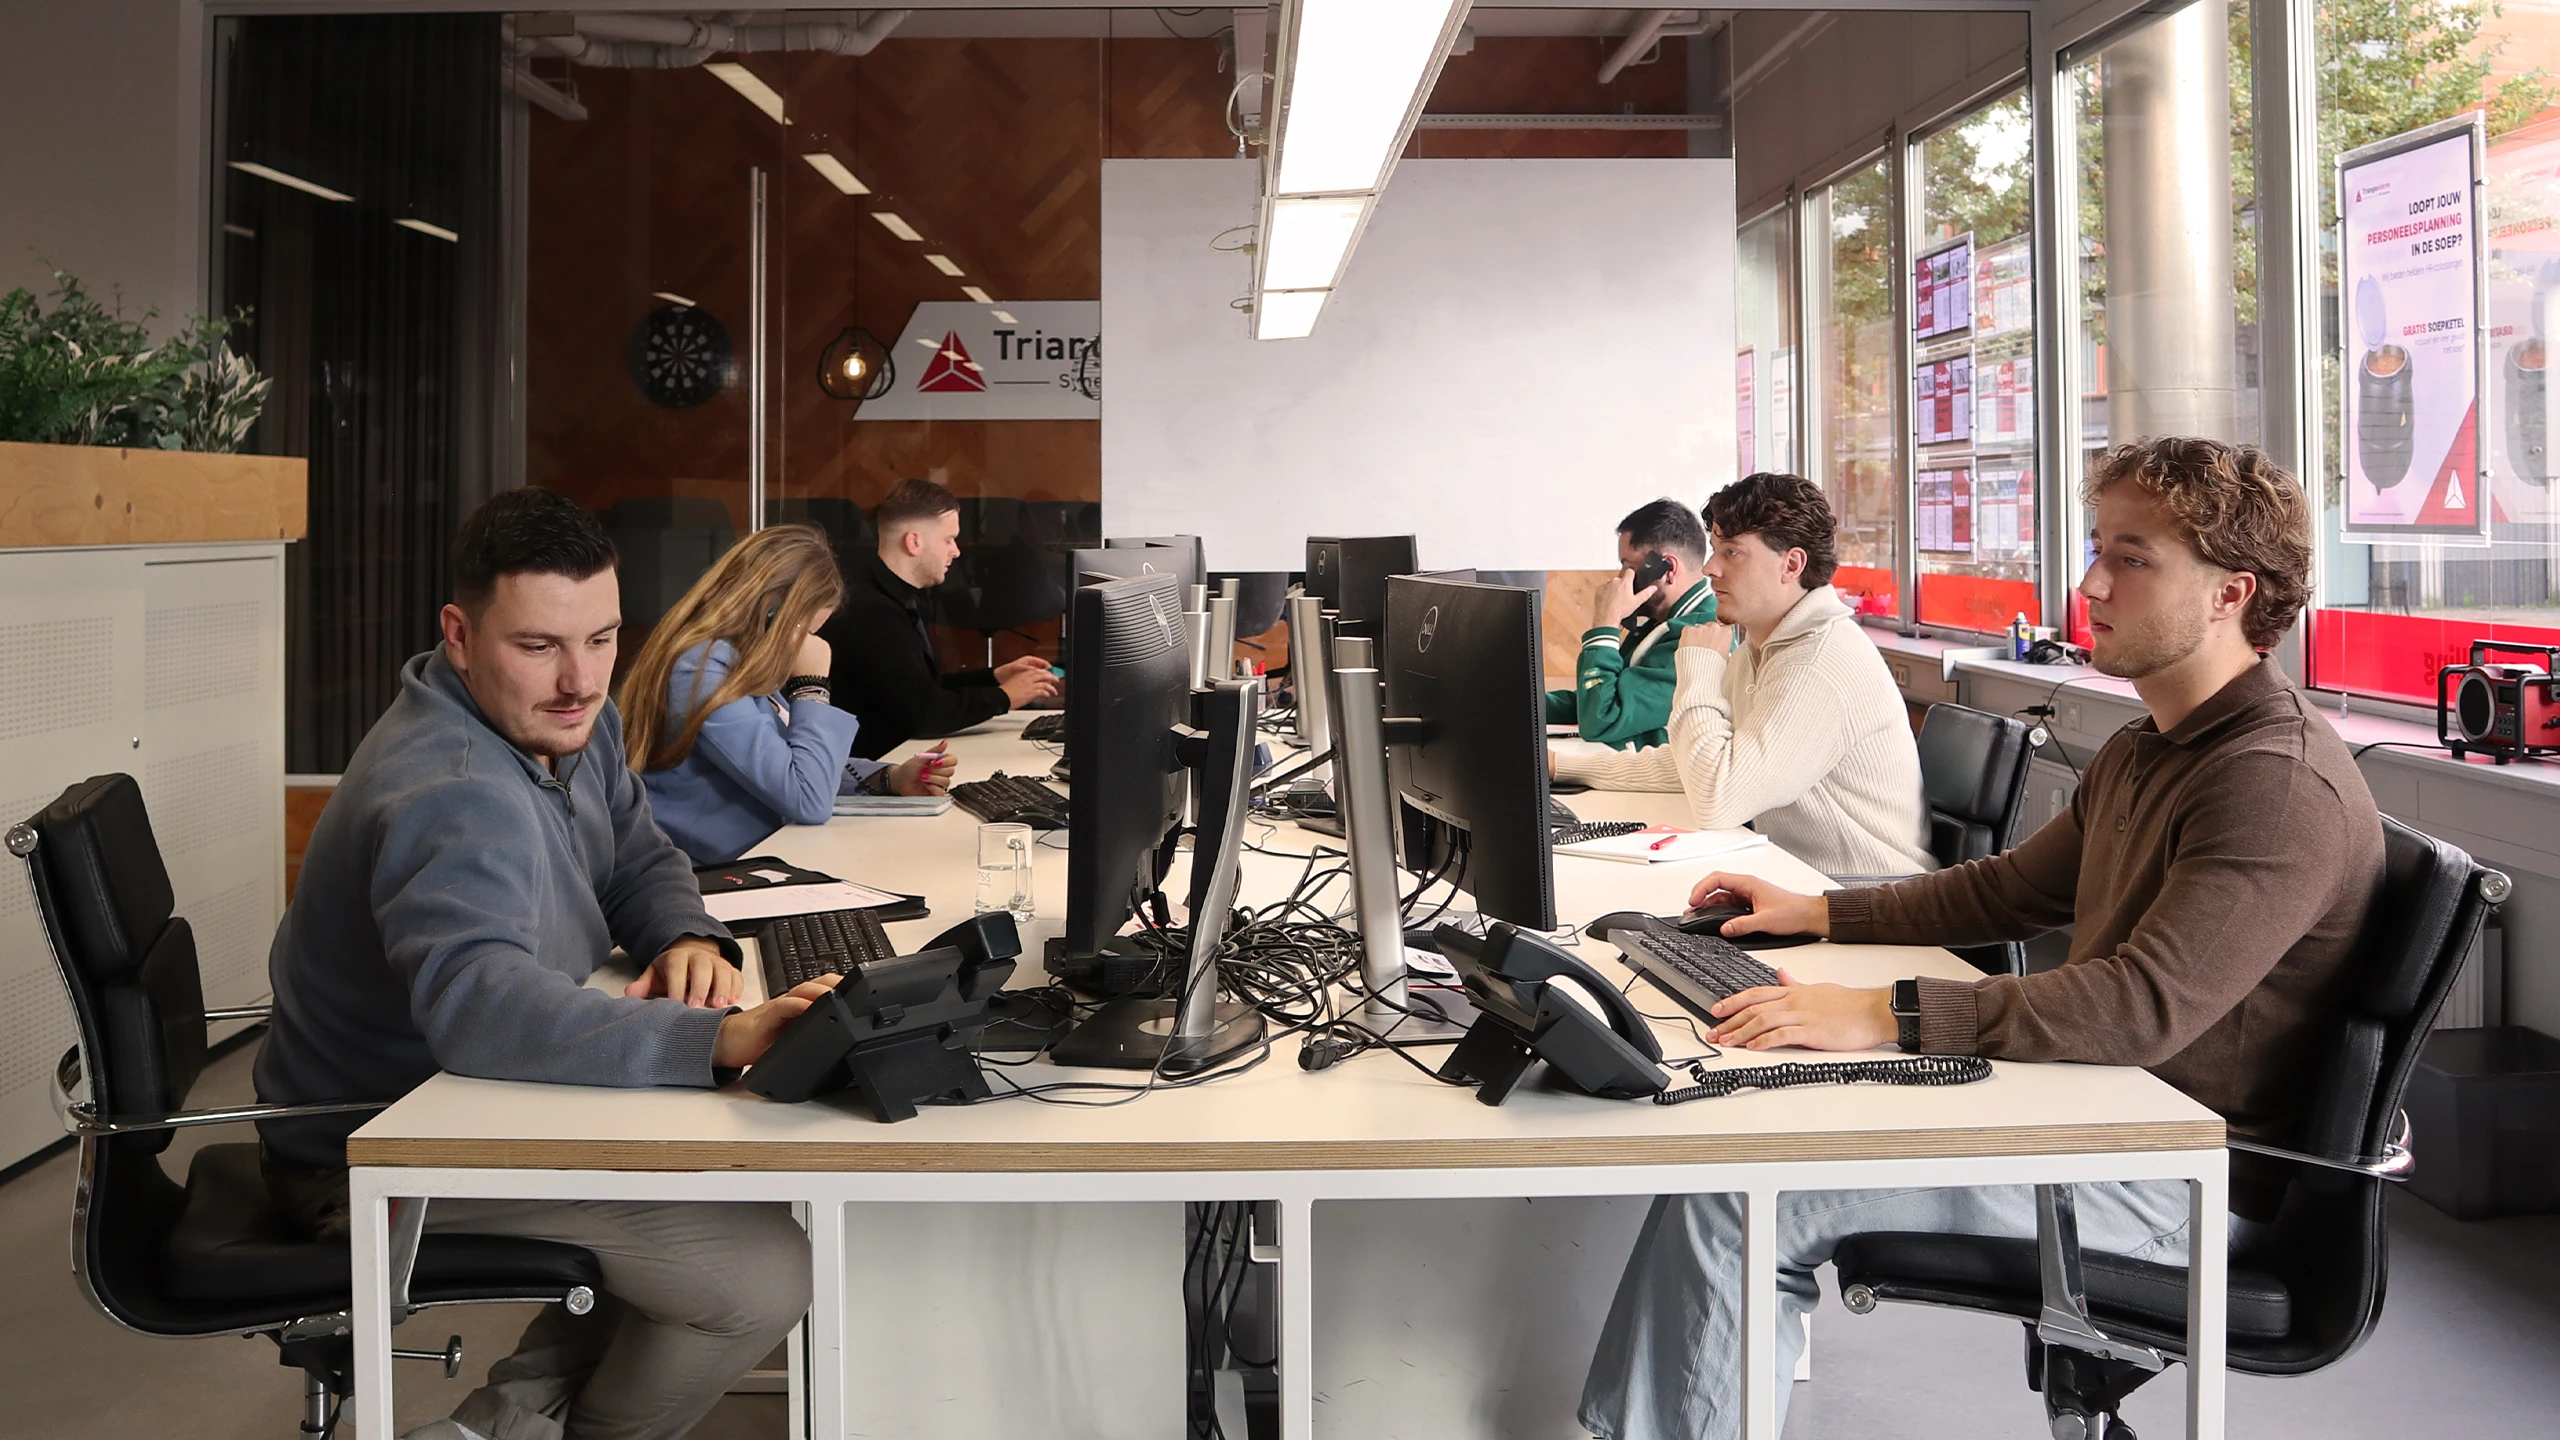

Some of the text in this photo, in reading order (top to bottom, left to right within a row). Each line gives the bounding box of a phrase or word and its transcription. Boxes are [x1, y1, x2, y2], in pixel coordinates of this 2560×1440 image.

[2409, 191, 2462, 216] LOOPT JOUW
[2367, 213, 2462, 246] PERSONEELSPLANNING
[2411, 234, 2463, 257] IN DE SOEP?
[2403, 317, 2465, 337] GRATIS SOEPKETEL
[993, 330, 1100, 360] Trian
